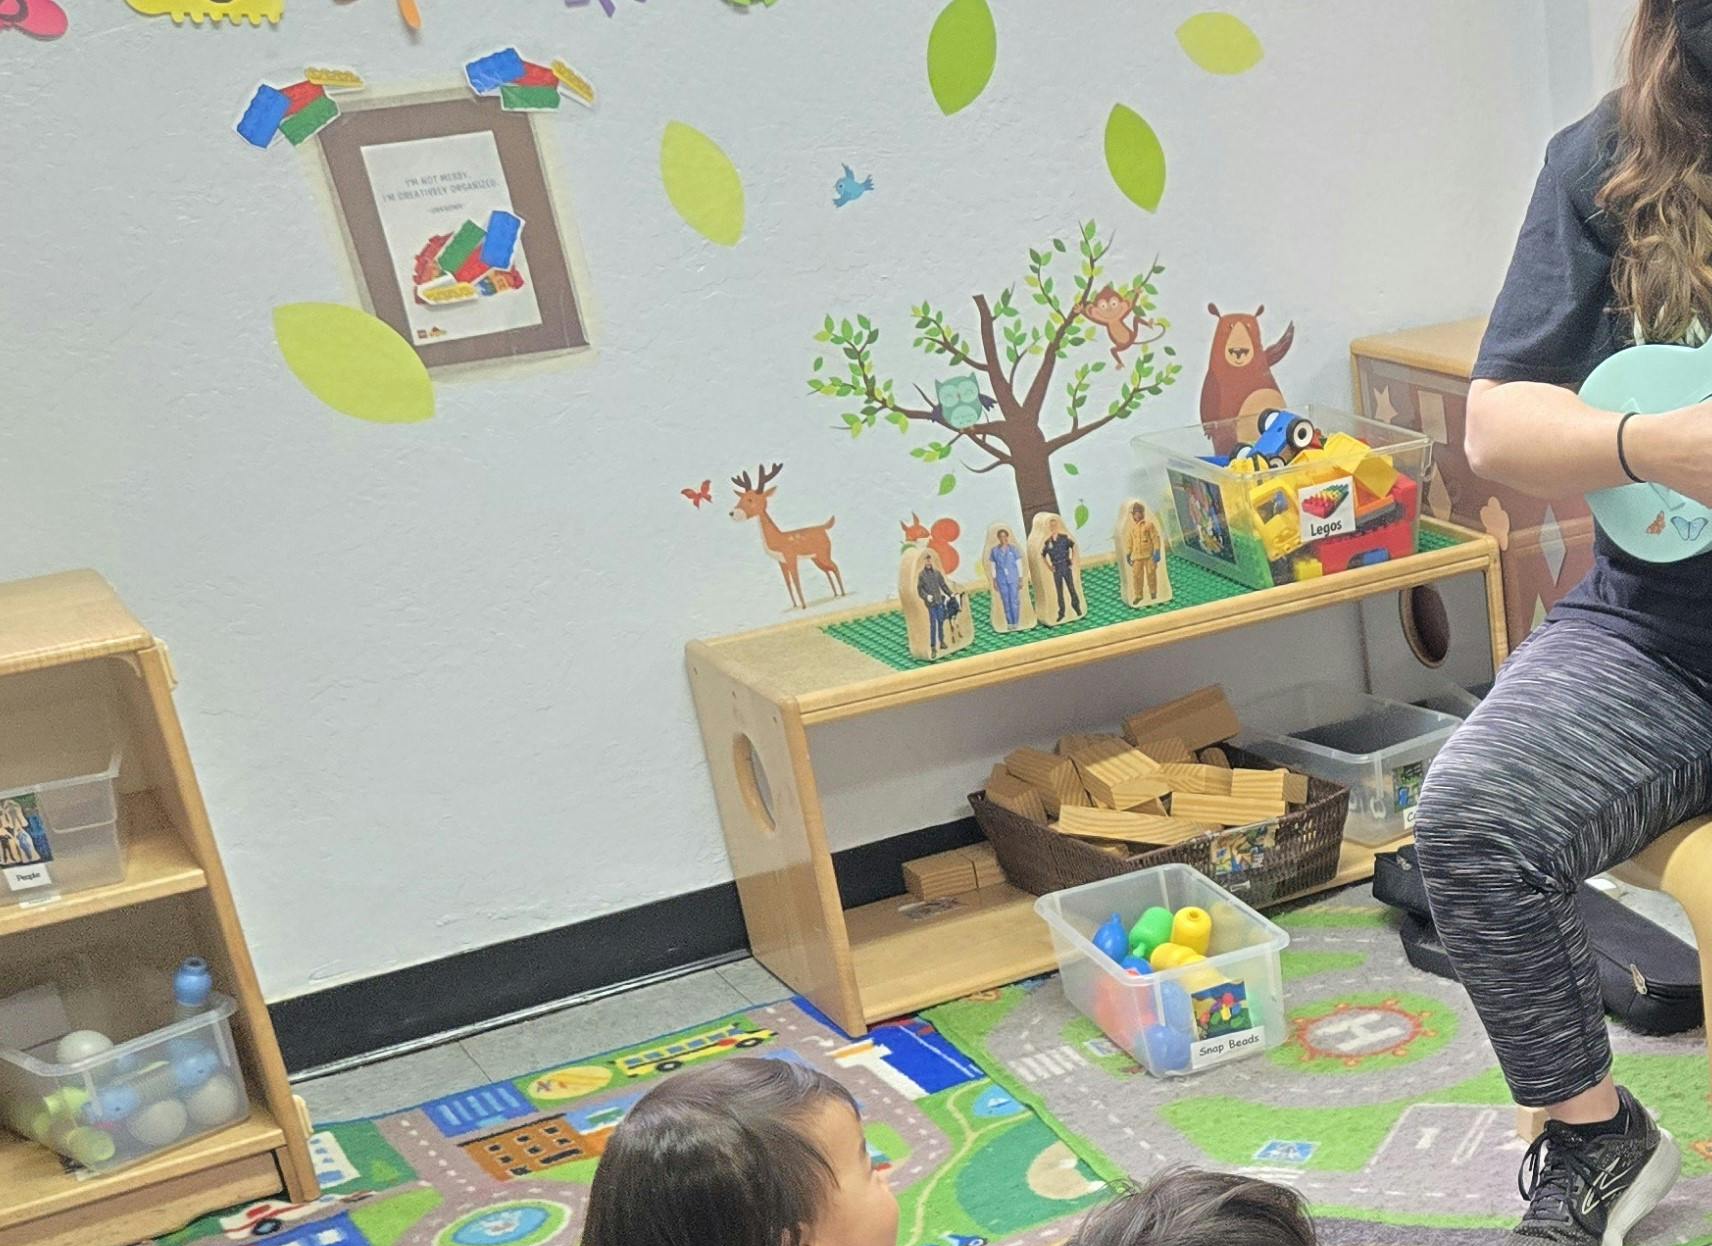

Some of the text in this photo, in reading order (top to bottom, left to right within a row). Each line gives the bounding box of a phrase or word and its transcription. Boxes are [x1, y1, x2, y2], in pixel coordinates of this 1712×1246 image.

[1310, 519, 1342, 538] Legos
[15, 872, 41, 882] People
[1199, 1034, 1260, 1057] Snap Beads
